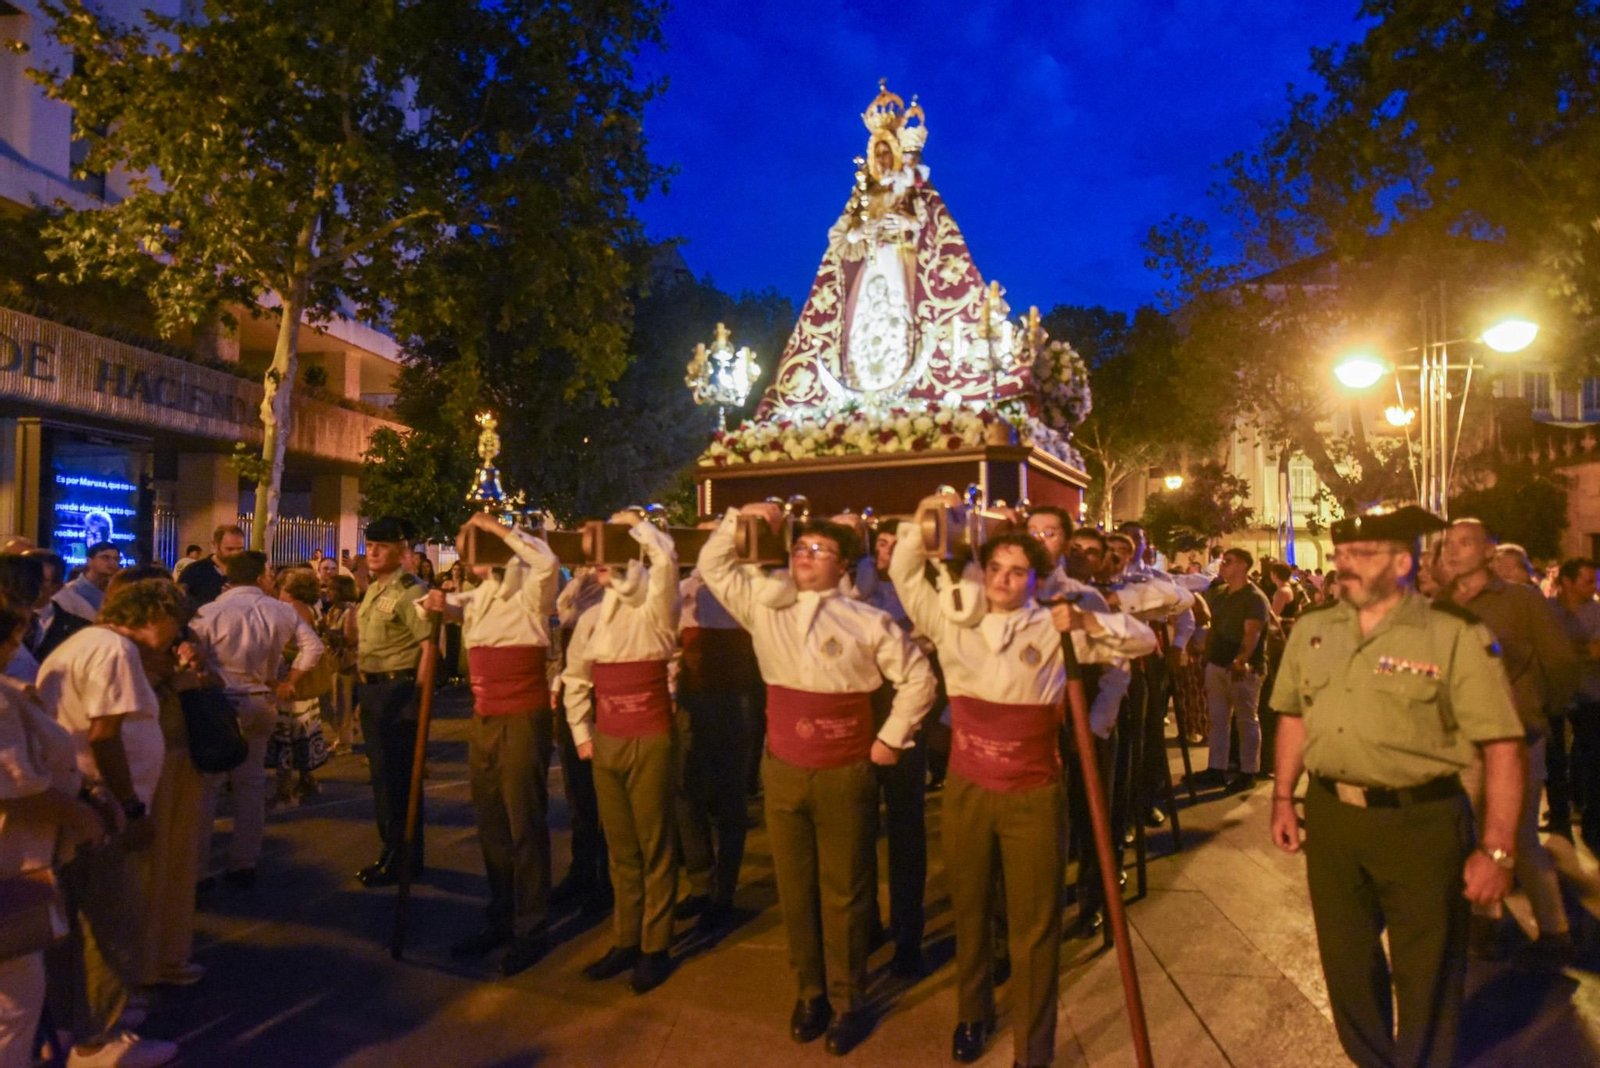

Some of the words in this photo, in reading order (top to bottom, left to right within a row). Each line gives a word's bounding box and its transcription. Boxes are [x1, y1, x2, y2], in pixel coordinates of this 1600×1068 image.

[66, 477, 79, 485] por
[108, 482, 120, 490] que
[55, 503, 78, 511] puede
[105, 505, 124, 515] hasta
[54, 530, 78, 538] recibe
